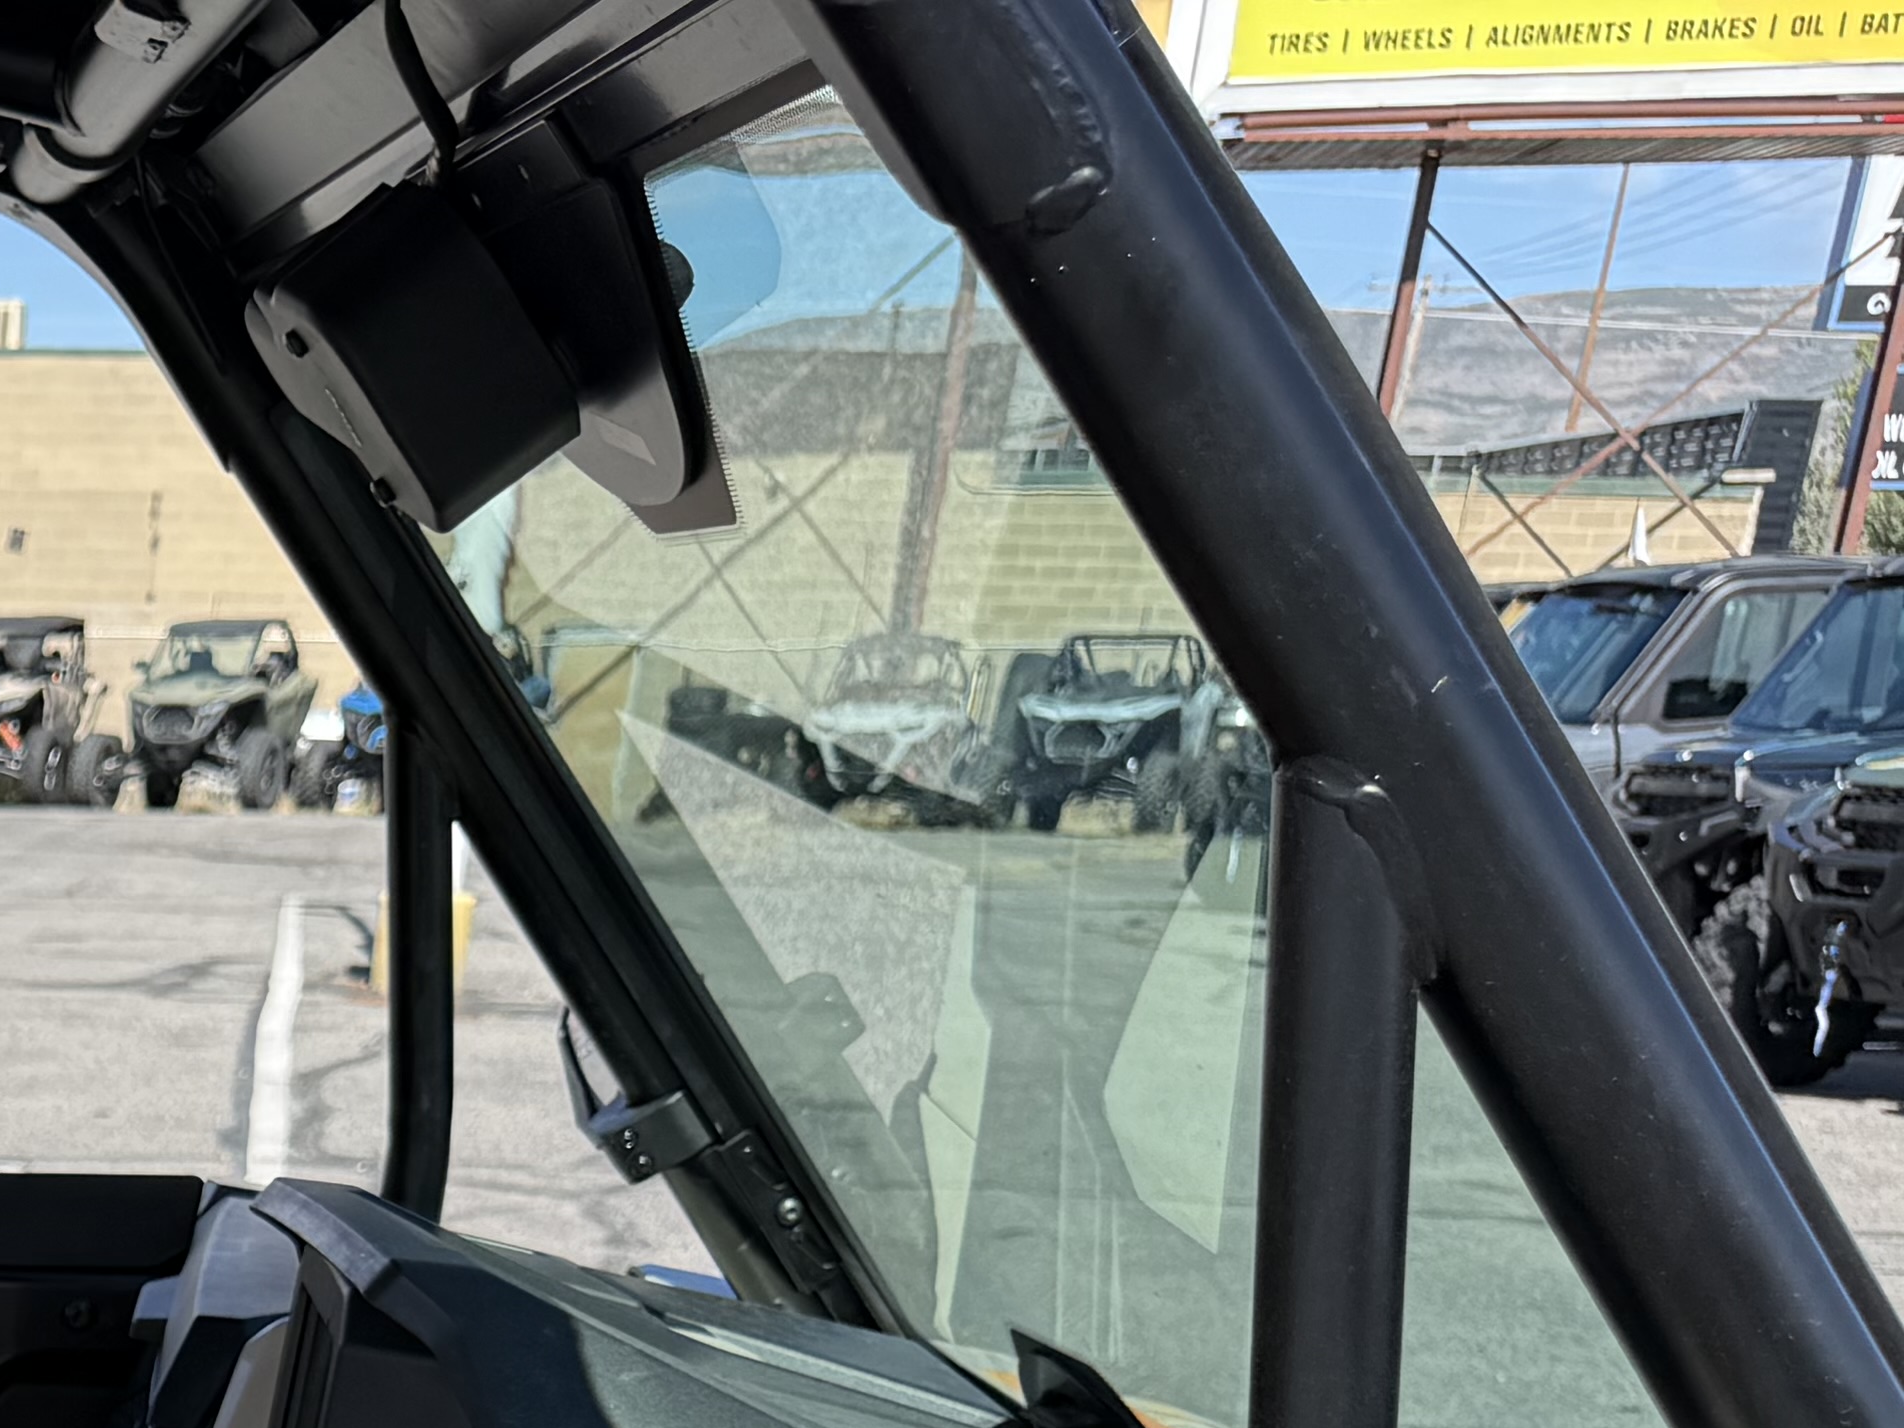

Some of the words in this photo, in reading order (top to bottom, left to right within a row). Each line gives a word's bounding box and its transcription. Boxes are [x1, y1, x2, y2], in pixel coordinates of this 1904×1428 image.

[1268, 31, 1330, 55] TIRES
[1363, 27, 1454, 52] WHEELS
[1485, 21, 1632, 48] ALIGNMENTS
[1665, 16, 1758, 41] BRAKES
[1790, 14, 1824, 37] OIL
